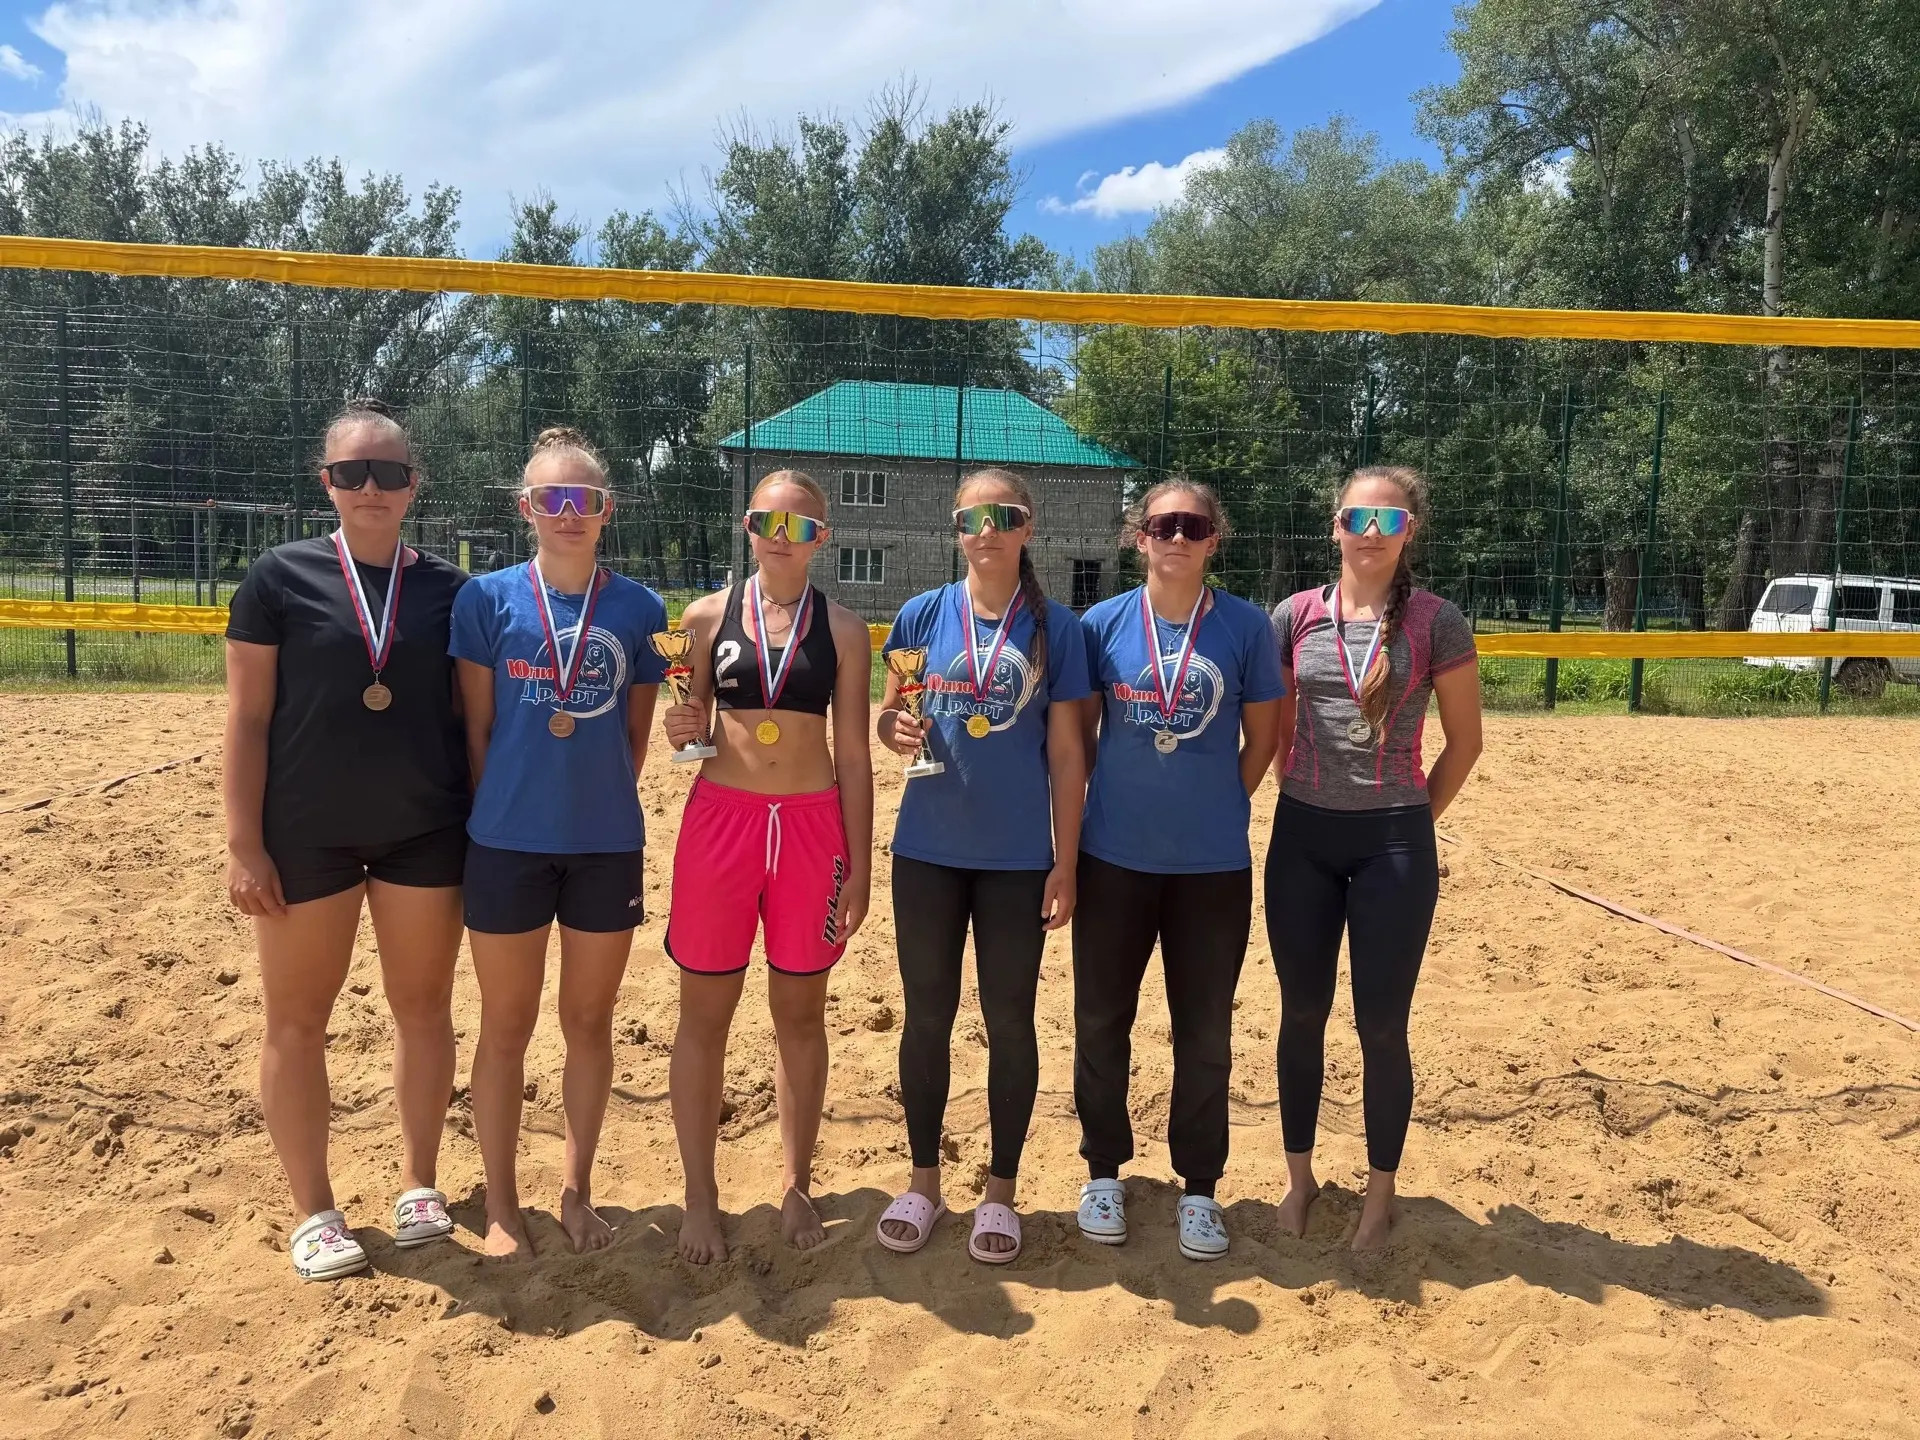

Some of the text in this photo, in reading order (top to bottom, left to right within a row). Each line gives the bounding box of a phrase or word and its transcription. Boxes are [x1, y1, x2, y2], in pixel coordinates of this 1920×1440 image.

[507, 659, 554, 681] ЮНИ
[716, 640, 742, 689] 2
[927, 673, 975, 694] ЮНИО
[1113, 682, 1161, 703] ЮНИО
[933, 693, 1003, 719] ДРАФТ
[1158, 734, 1174, 746] 2
